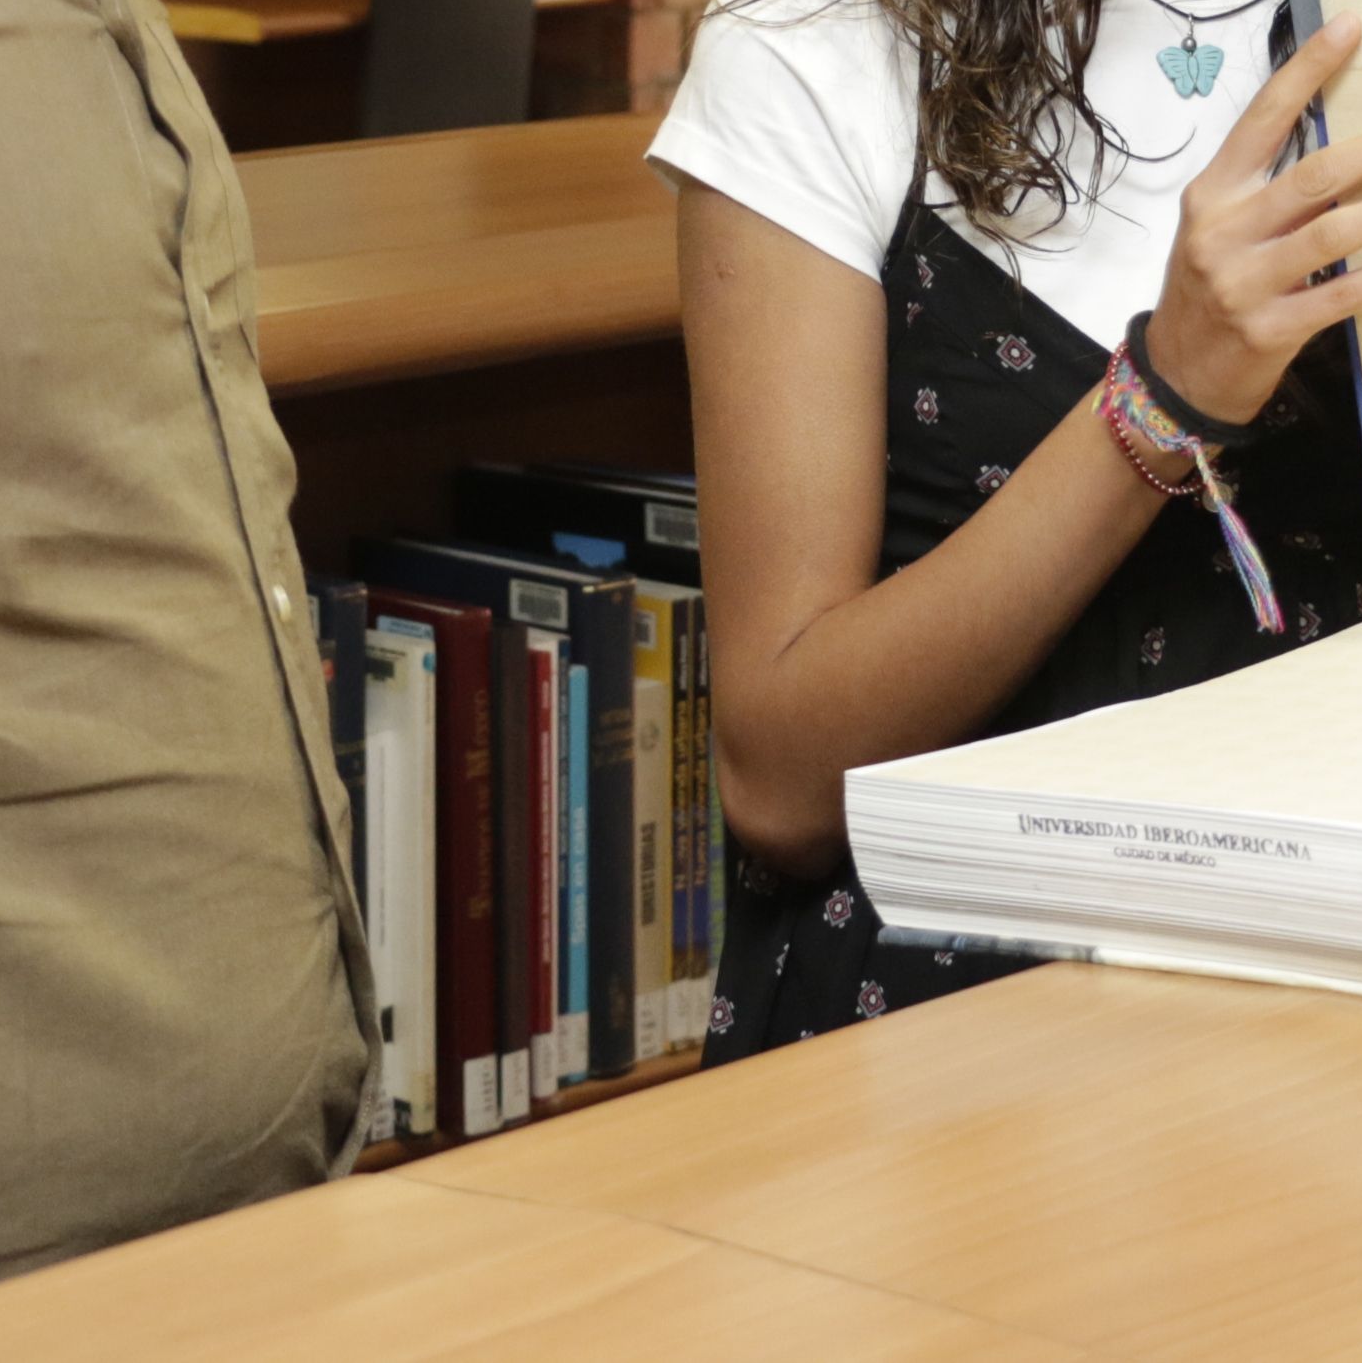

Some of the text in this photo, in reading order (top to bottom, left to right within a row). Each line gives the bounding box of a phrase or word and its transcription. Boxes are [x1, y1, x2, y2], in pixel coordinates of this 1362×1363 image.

[1018, 814, 1312, 861] UNIVERSIDAD IBEROAMERICANA
[1114, 846, 1155, 861] CIUDAD
[1157, 850, 1173, 863] DE
